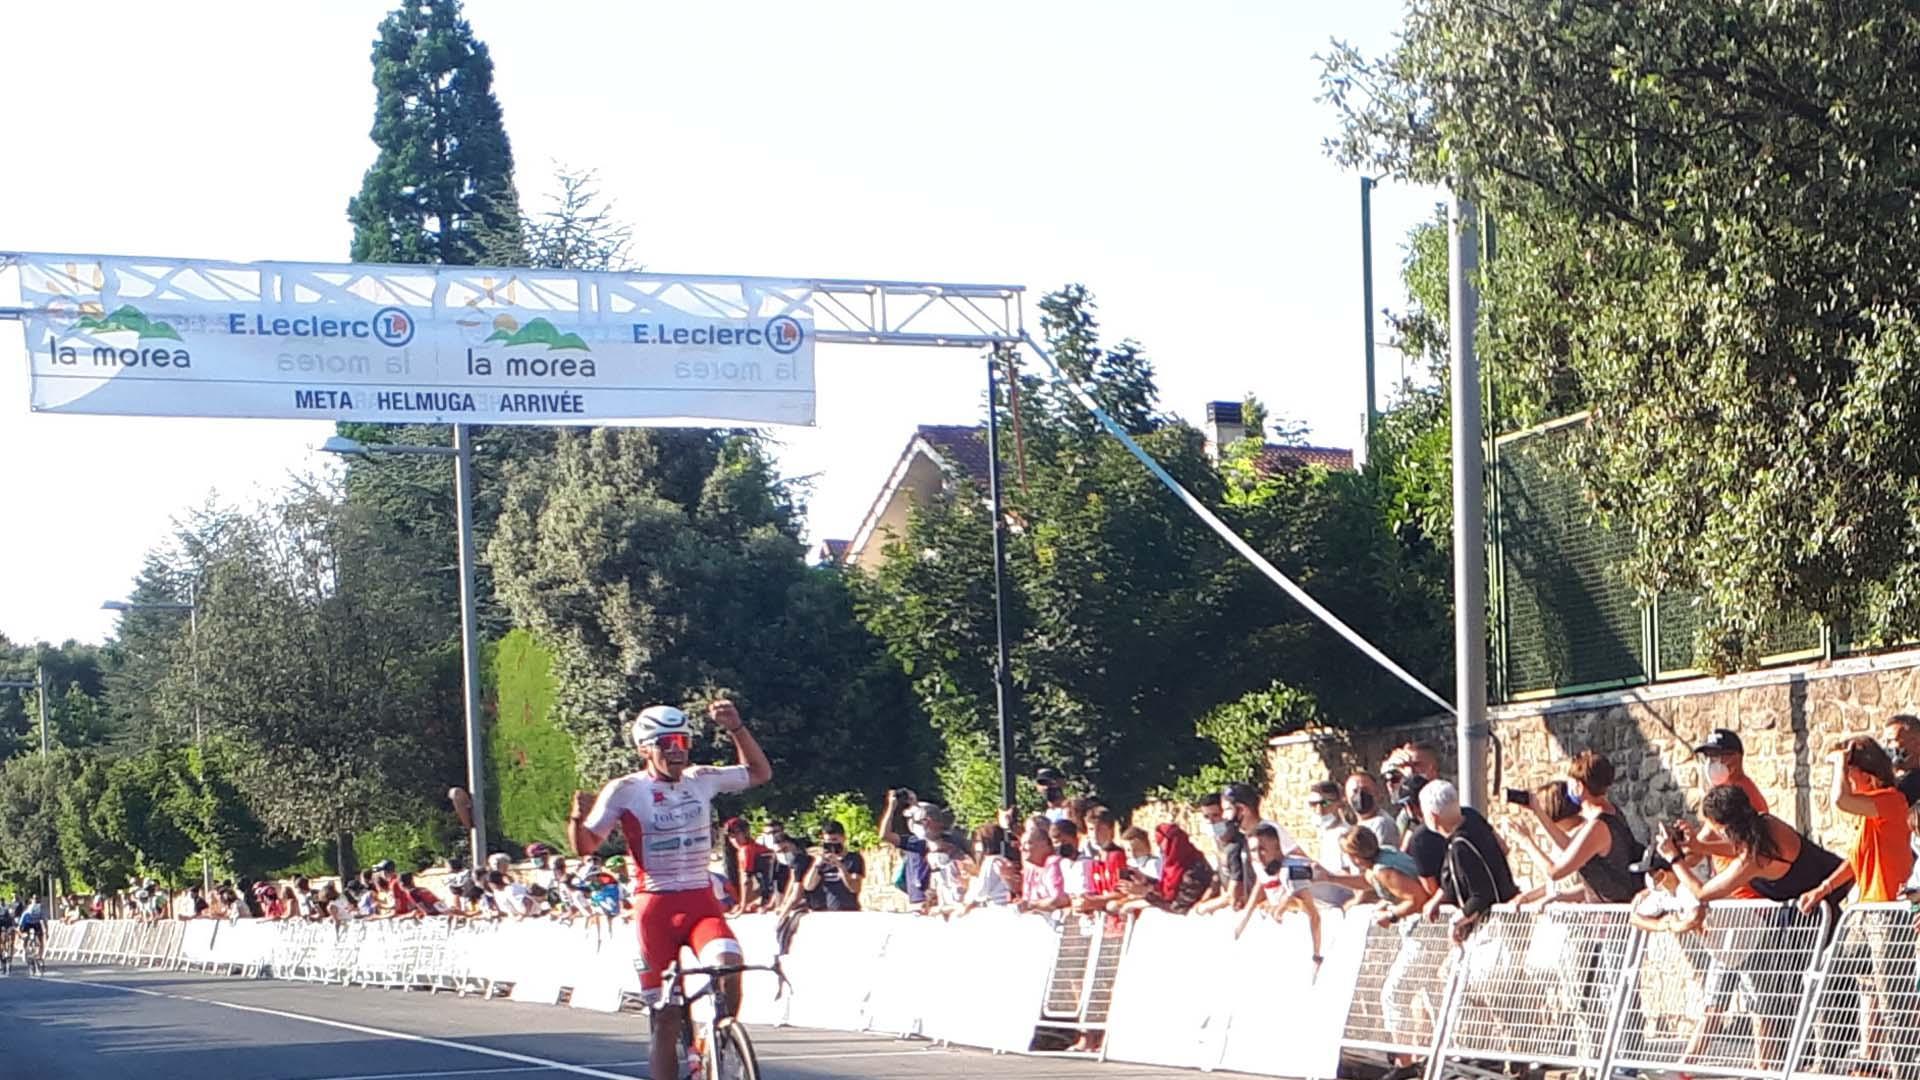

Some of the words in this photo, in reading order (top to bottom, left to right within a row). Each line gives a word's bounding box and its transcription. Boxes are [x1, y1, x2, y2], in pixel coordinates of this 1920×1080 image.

[228, 312, 369, 339] E.Leclerc
[632, 323, 763, 347] E.Leclerc
[49, 335, 78, 366] la
[92, 344, 192, 369] morea
[467, 347, 492, 376] la
[506, 355, 596, 378] morea
[294, 389, 354, 410] META
[376, 391, 476, 412] HELMUGA
[499, 390, 585, 413] ARRIVÉE
